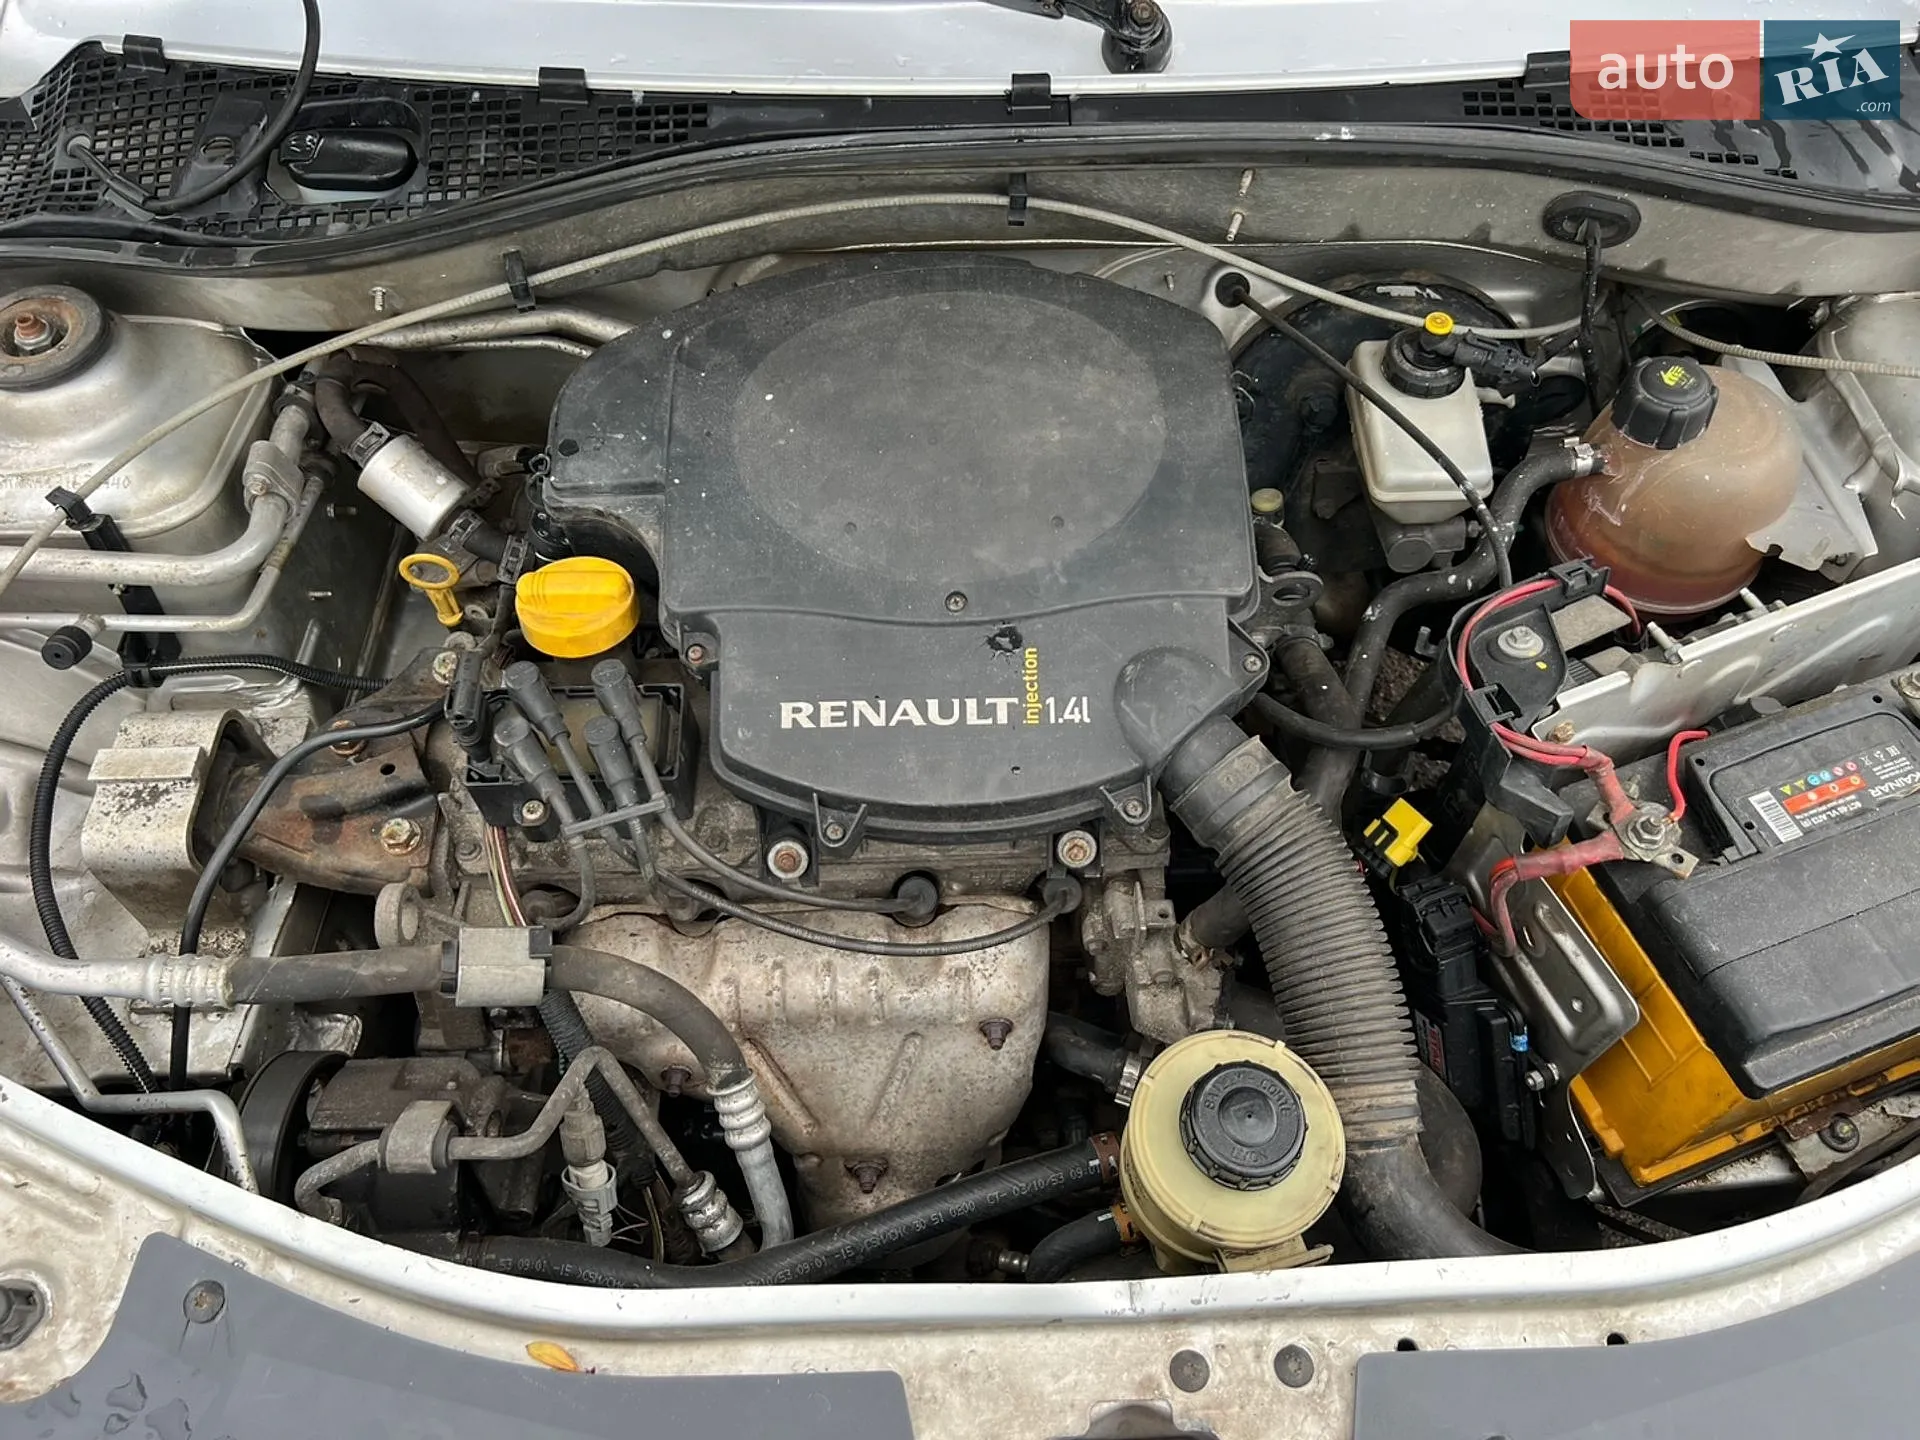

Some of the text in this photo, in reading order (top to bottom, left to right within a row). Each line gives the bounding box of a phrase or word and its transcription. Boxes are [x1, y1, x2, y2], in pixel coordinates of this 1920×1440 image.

[780, 697, 1019, 730] RENAULT
[1021, 646, 1040, 726] injection
[1868, 771, 1920, 798] KAINAR
